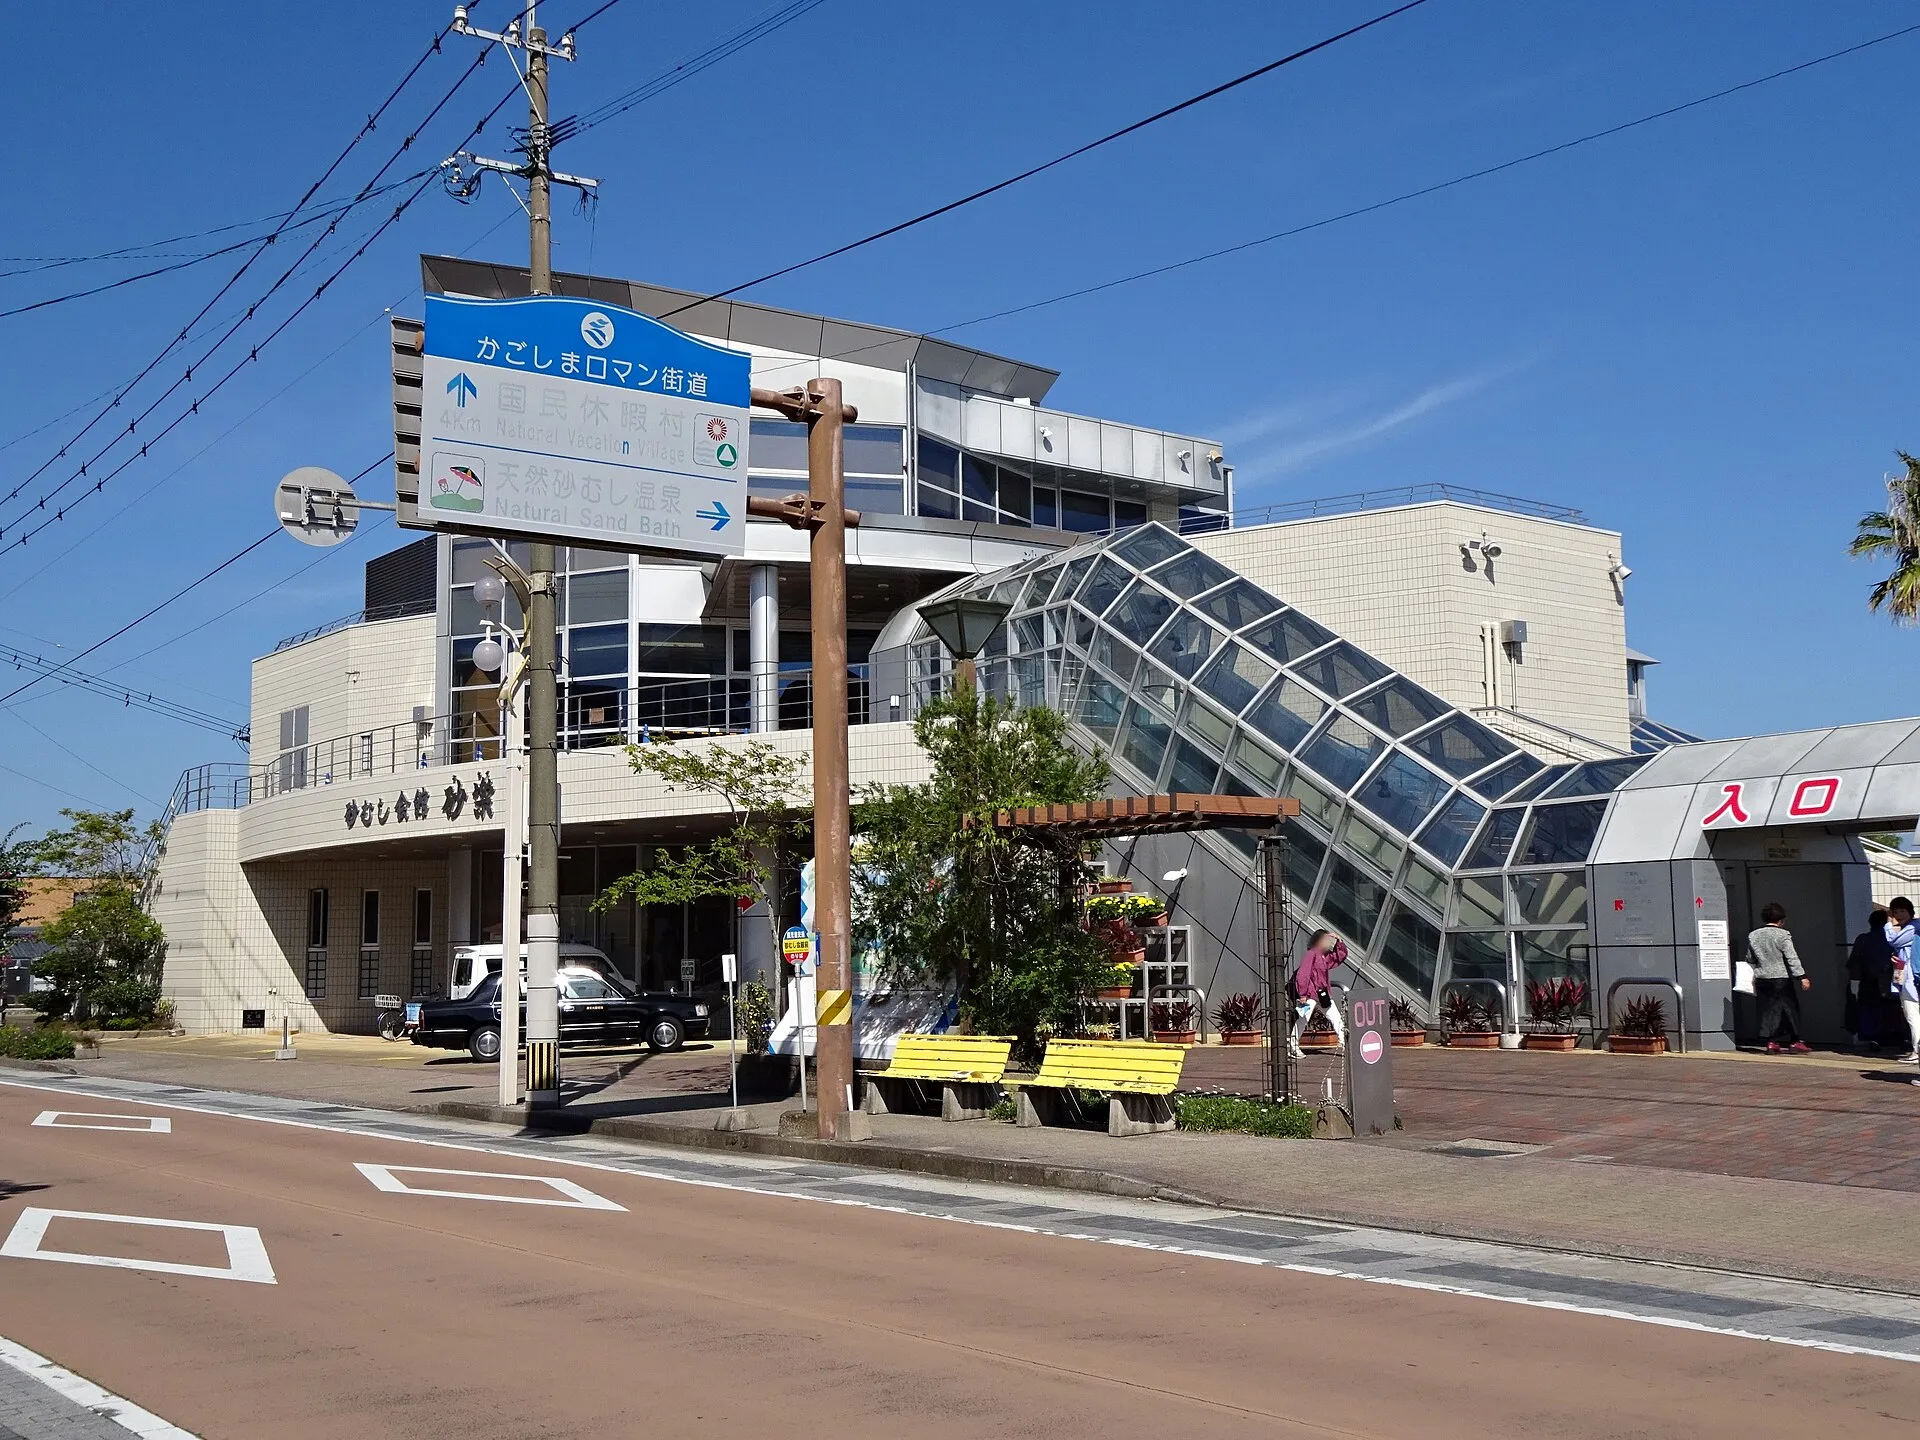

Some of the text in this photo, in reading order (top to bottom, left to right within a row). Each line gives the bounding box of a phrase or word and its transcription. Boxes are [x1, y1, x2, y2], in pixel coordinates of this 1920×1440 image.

[476, 335, 709, 397] かごしまロマン街道
[497, 382, 686, 439] 国民休暇村
[496, 416, 686, 464] National Vacation Village
[496, 461, 682, 515] 天然砂むし温泉
[495, 496, 682, 539] Natural Sand Bath
[344, 786, 431, 831] 砂むし会館
[1700, 775, 1843, 828] 入口
[1353, 999, 1386, 1028] OUT
